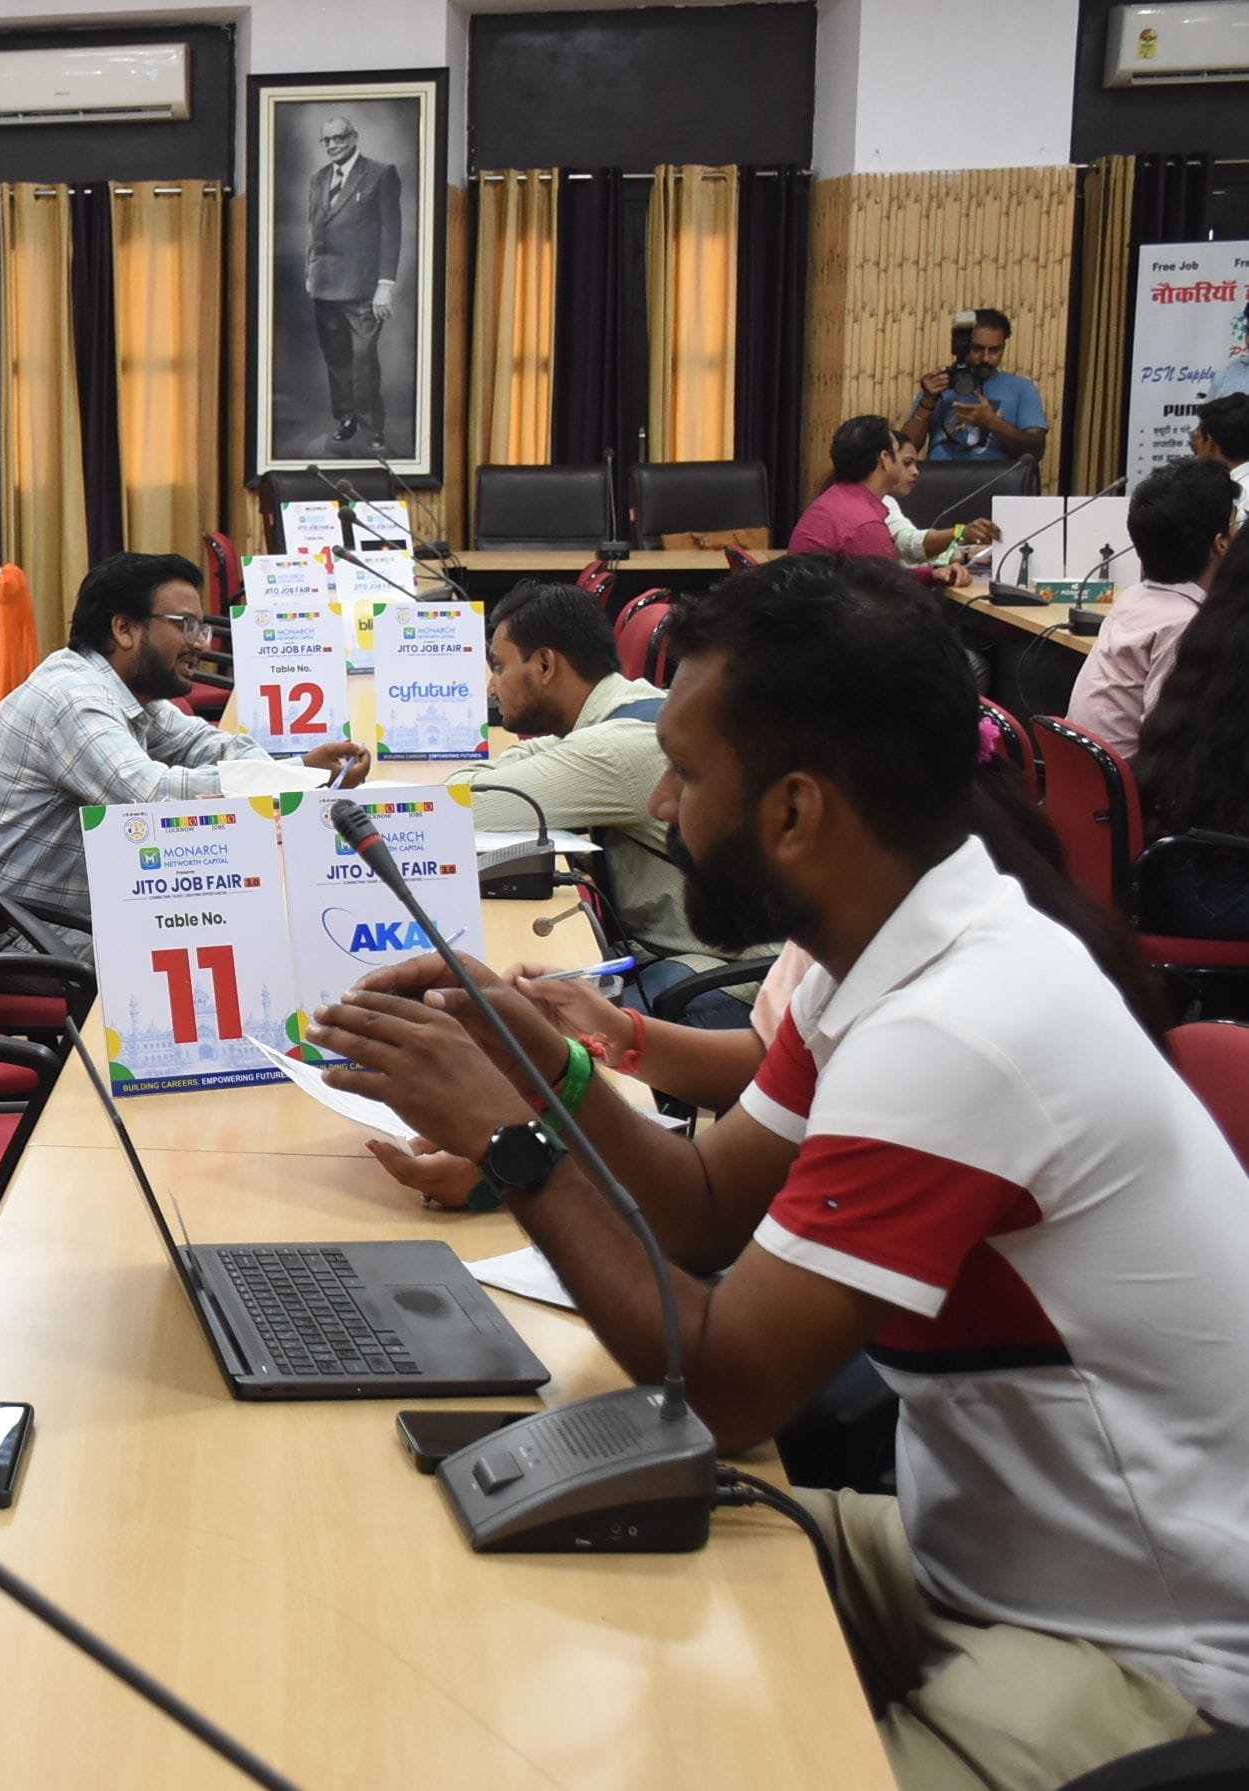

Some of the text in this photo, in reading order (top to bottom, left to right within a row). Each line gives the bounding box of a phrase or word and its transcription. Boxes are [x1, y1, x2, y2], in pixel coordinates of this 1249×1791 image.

[1152, 261, 1199, 272] Free Job
[1234, 258, 1249, 268] Fre
[1141, 365, 1216, 384] PSN Supply
[359, 619, 373, 631] bli
[258, 646, 279, 655] JITO
[281, 645, 299, 654] JOB
[301, 645, 321, 653] FAIR
[398, 645, 418, 653] JITO
[420, 644, 439, 653] JOB
[441, 644, 461, 652] FAIR
[270, 664, 312, 673] Table No.
[388, 681, 469, 702] cyfuture
[260, 682, 327, 735] 12
[381, 832, 424, 843] NARCH
[163, 844, 228, 857] MONARCH
[164, 858, 229, 868] NETWORTH CAPITAL
[326, 864, 362, 880] JITO
[402, 861, 437, 876] FAIR
[132, 879, 167, 895] JITO
[171, 876, 203, 892] JOB
[206, 874, 242, 890] FAIR
[155, 912, 227, 928] Table No.
[350, 920, 437, 952] AKA
[151, 945, 242, 1043] 11
[122, 1081, 159, 1092] BUILDING
[201, 1073, 254, 1085] EMPOWERING
